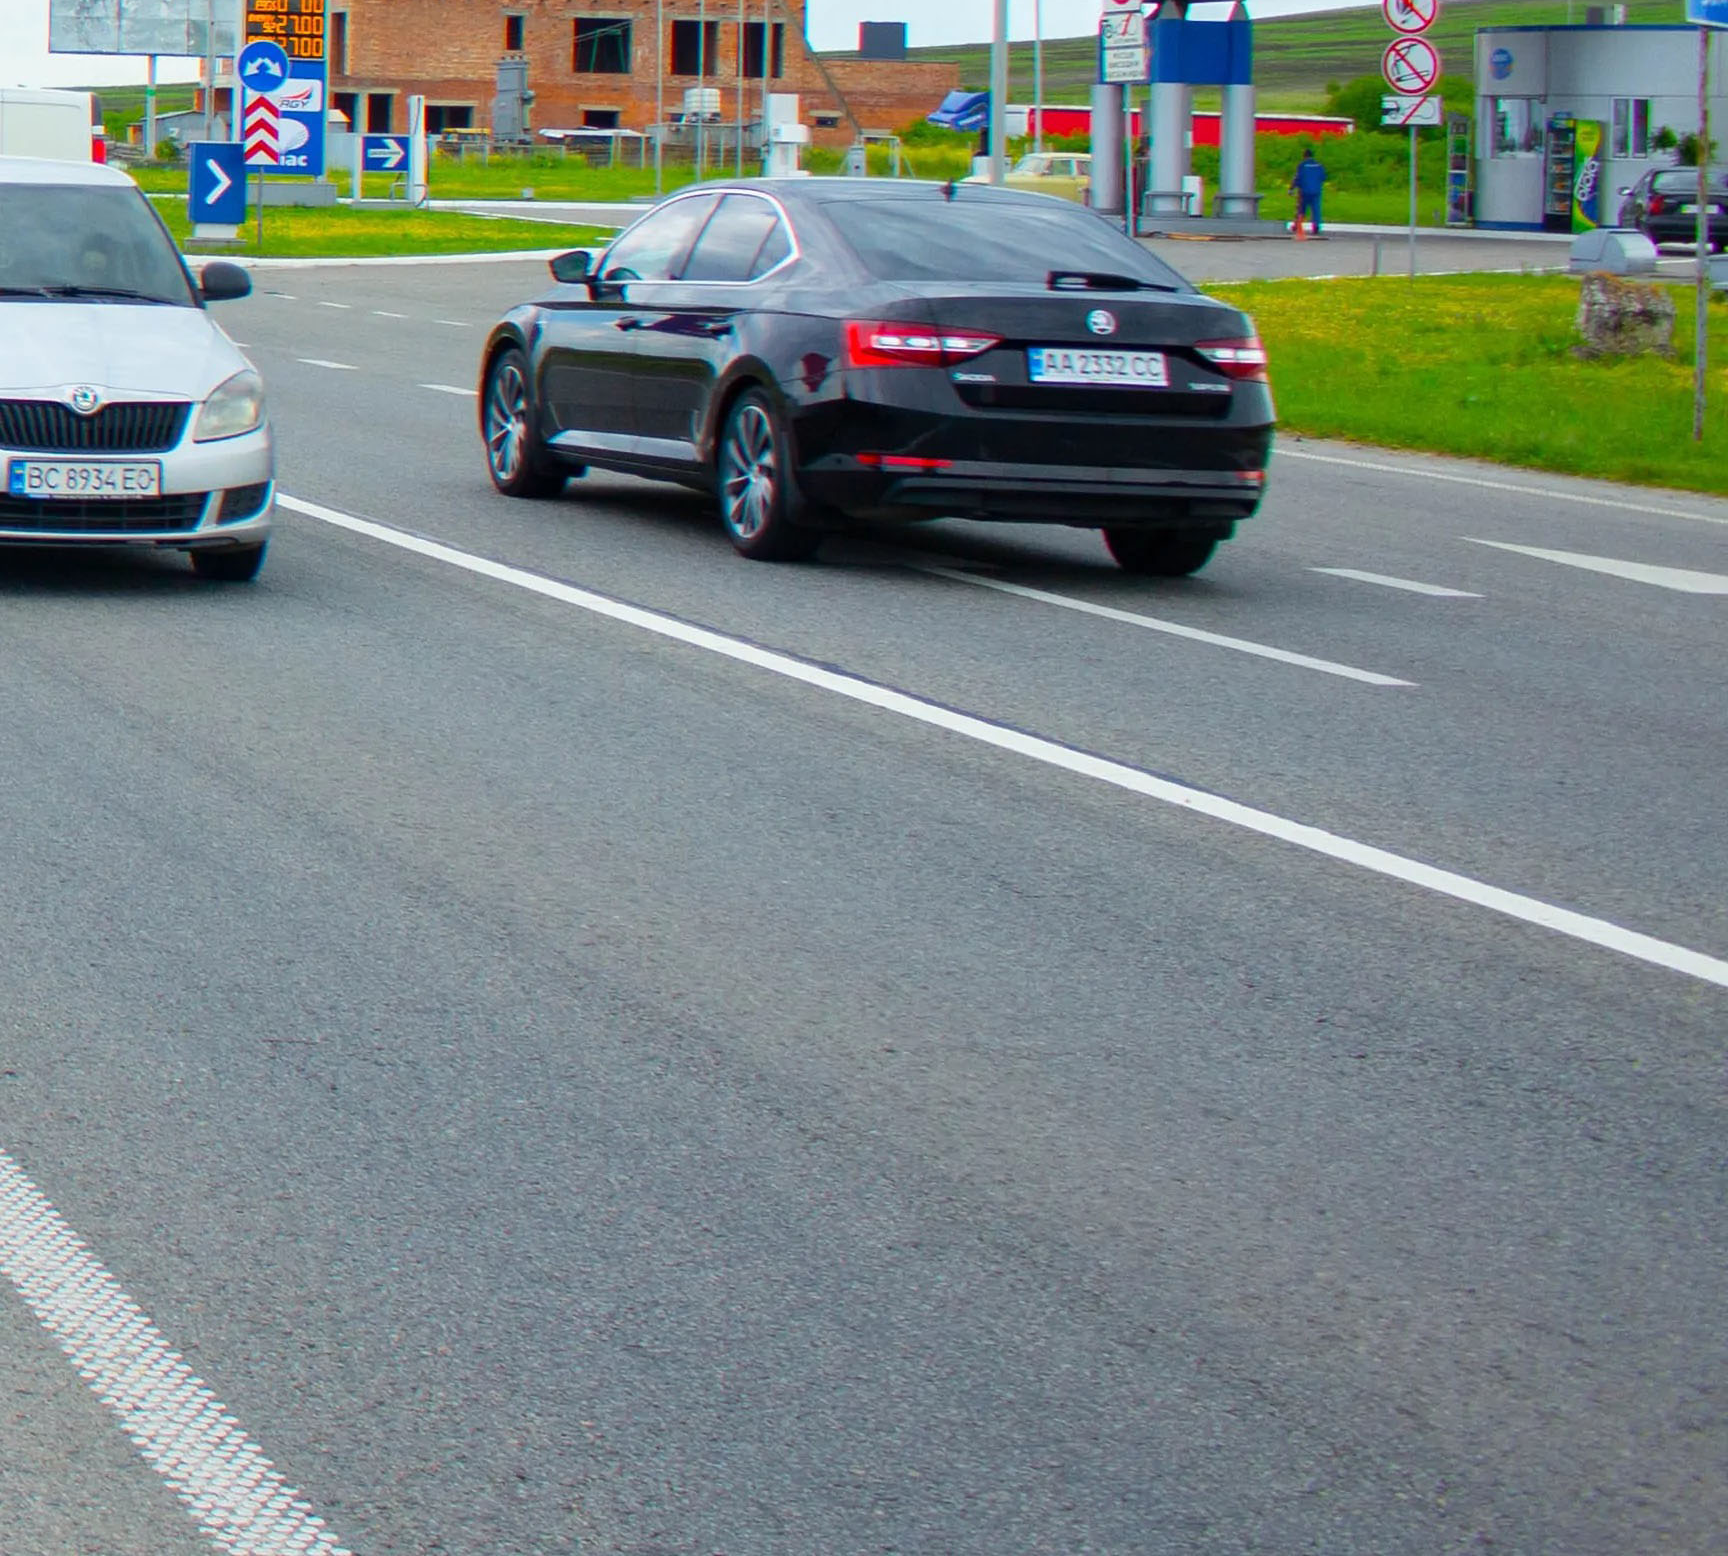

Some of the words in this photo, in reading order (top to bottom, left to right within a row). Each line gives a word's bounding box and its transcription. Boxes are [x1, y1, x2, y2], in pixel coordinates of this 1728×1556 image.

[1046, 353, 1076, 373] AA
[1079, 354, 1127, 376] 2332
[1132, 355, 1162, 377] CC
[28, 466, 60, 489] BC
[66, 468, 116, 490] 8934
